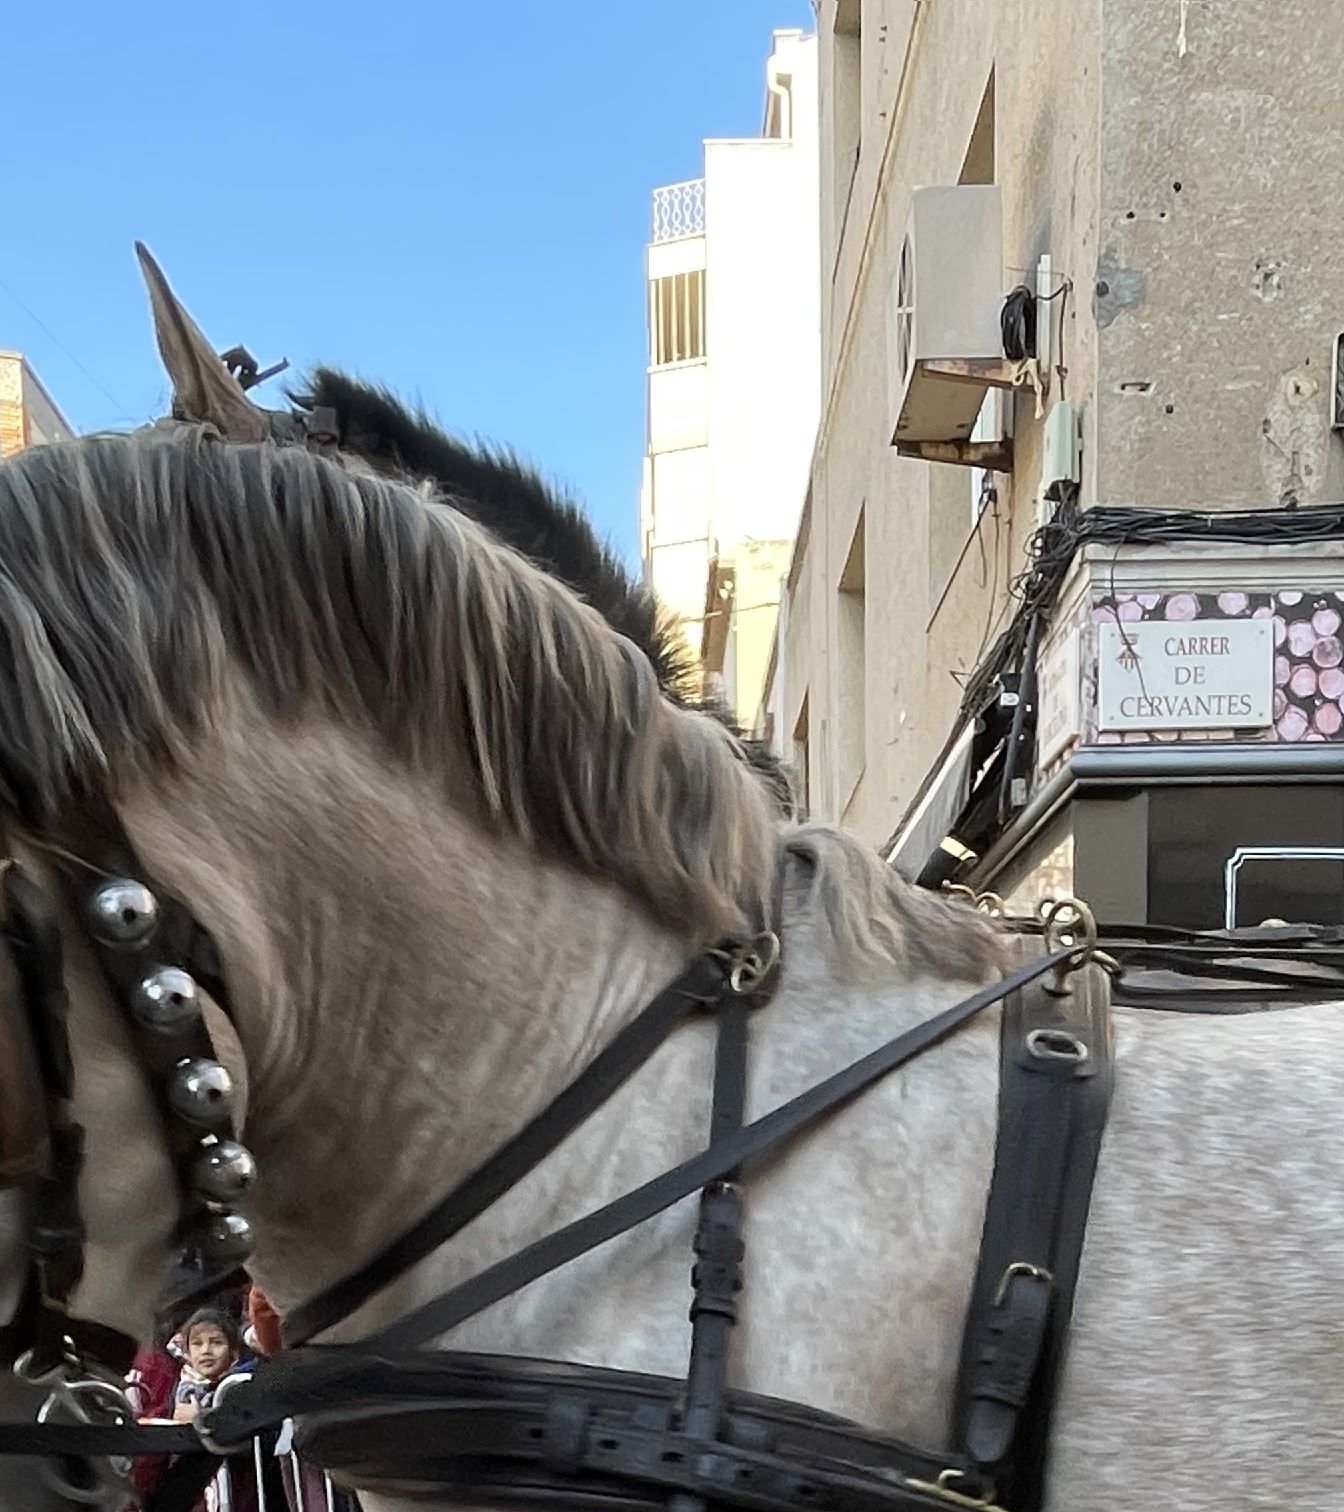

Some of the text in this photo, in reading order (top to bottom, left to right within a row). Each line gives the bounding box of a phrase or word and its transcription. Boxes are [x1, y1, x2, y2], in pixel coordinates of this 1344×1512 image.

[1164, 637, 1231, 656] CARRER
[1174, 666, 1206, 685] DE
[1120, 694, 1252, 718] CERVANTES
